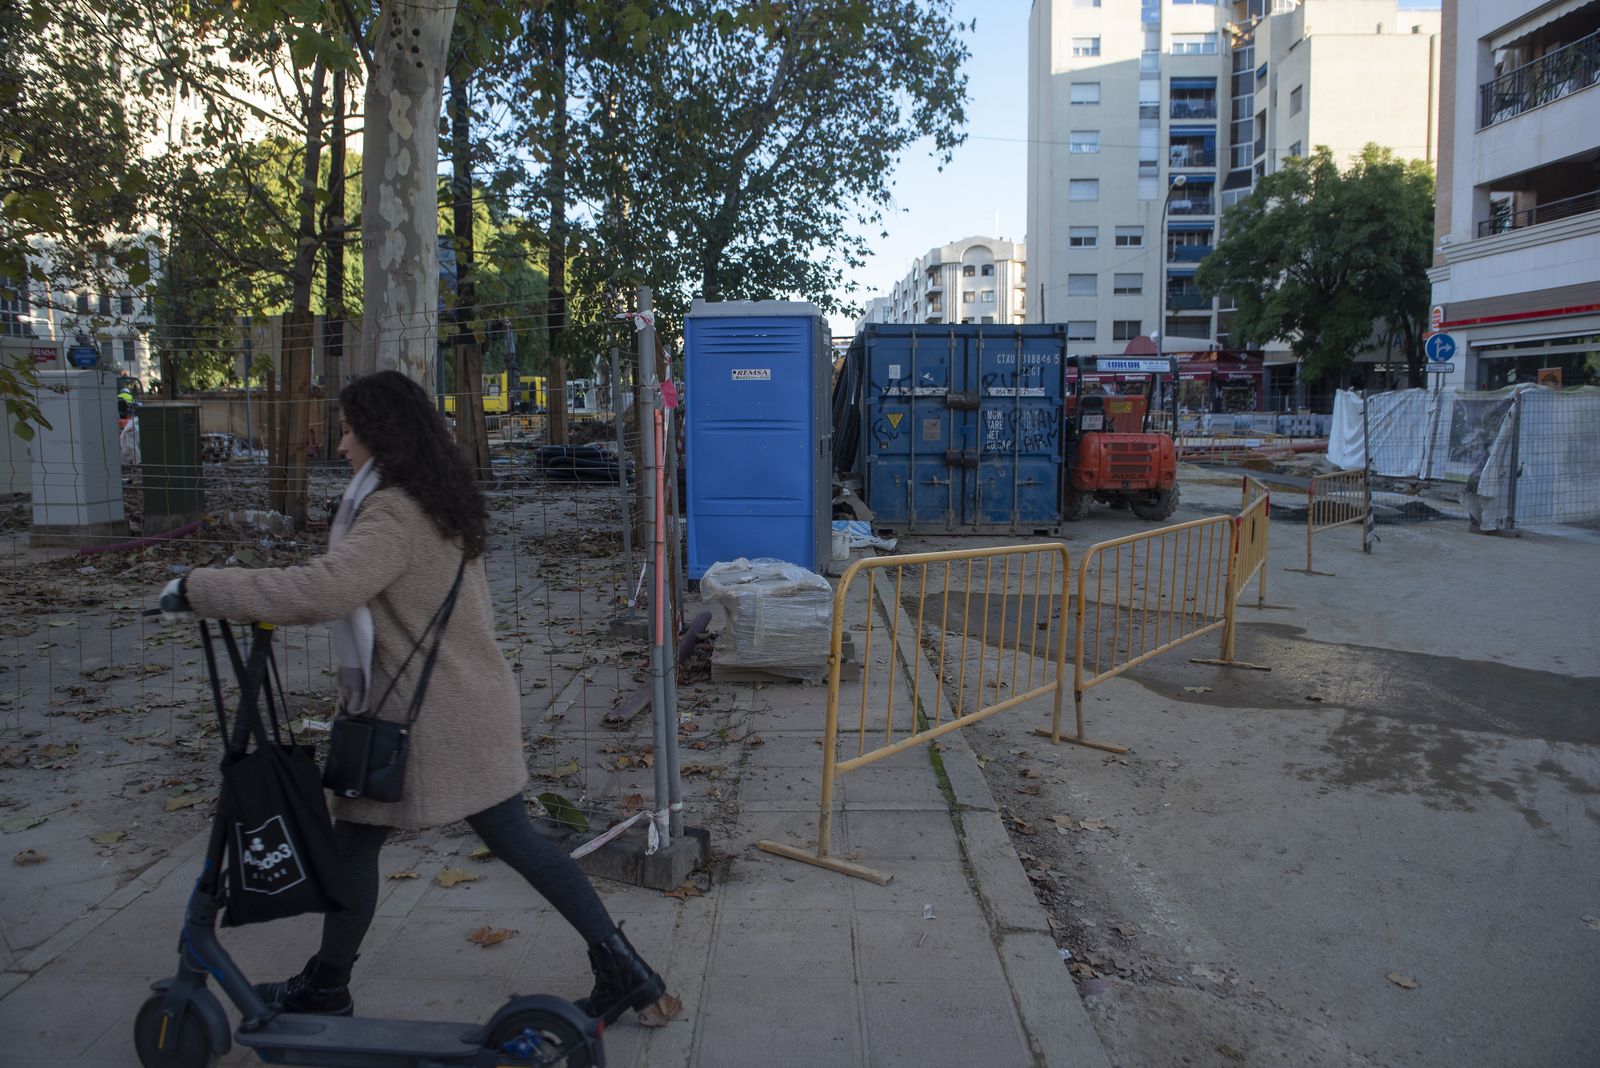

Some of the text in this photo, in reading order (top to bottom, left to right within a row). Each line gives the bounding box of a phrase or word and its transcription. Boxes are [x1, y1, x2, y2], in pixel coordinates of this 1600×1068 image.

[997, 353, 1060, 364] CTXU 318846 5
[987, 420, 1004, 430] TARE
[987, 430, 1000, 440] NET
